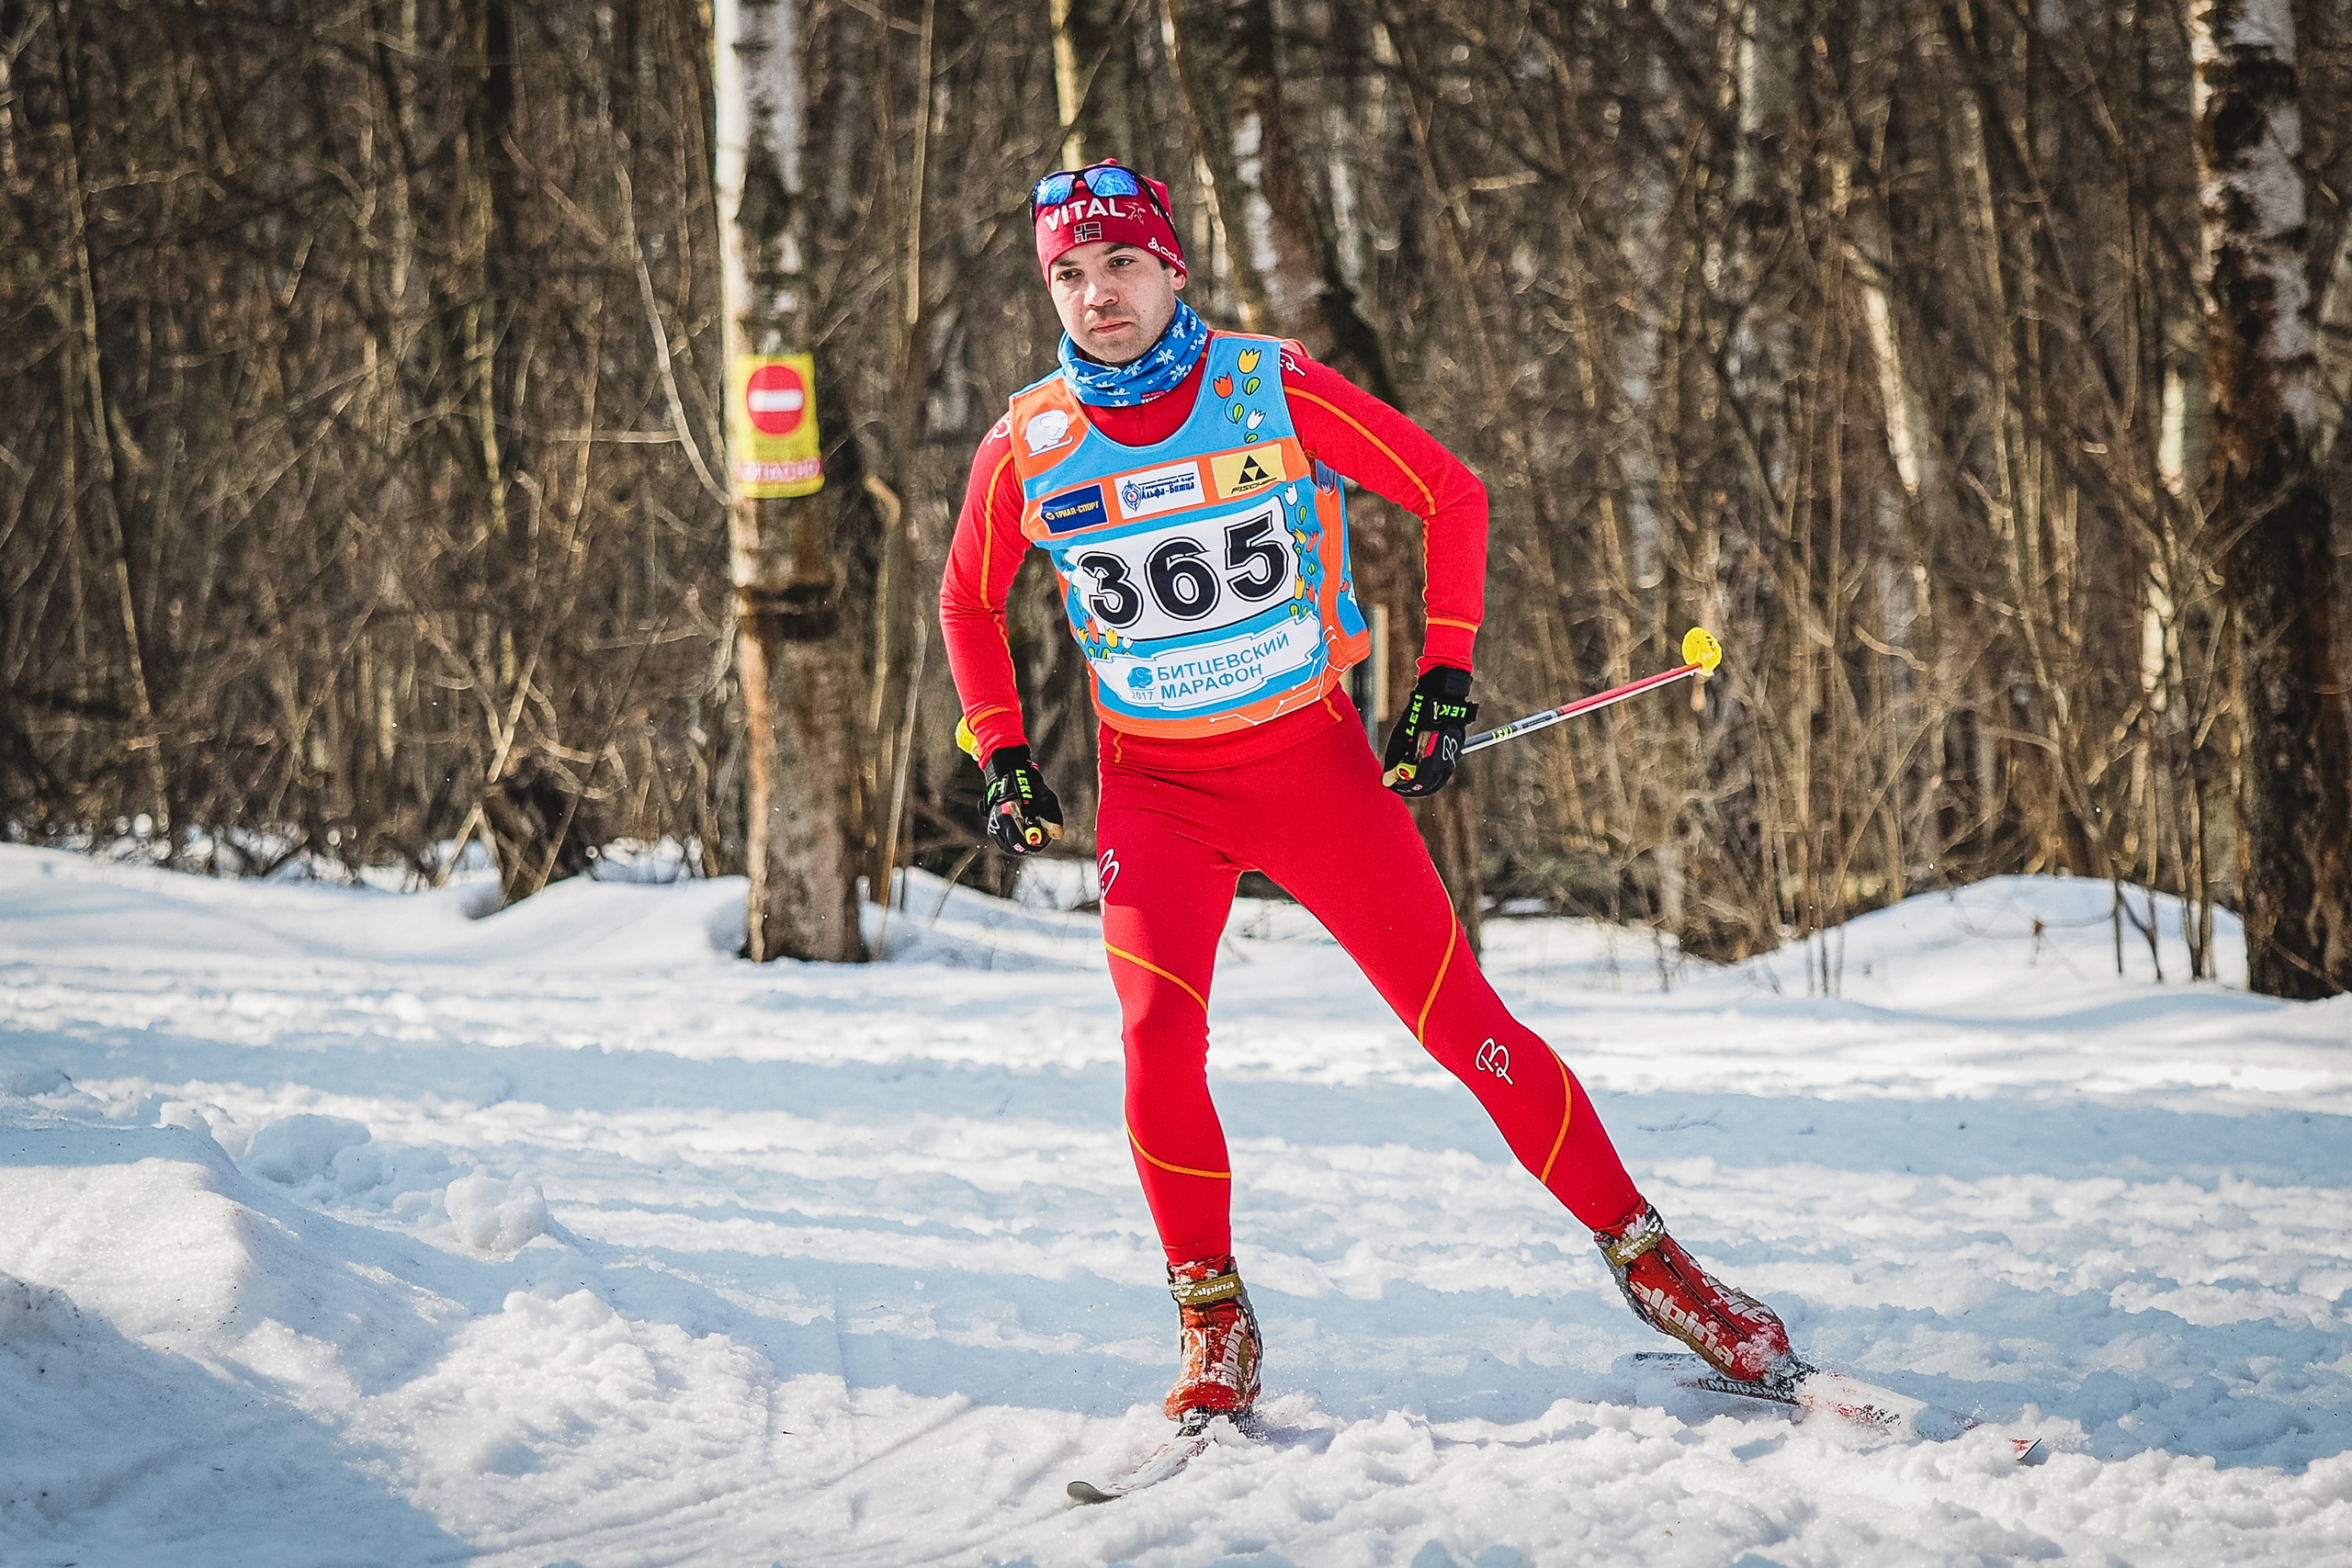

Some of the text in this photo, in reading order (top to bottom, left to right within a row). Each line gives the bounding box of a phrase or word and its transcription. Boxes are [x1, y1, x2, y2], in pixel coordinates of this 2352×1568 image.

[1046, 197, 1126, 231] VITAL
[1078, 511, 1288, 630] 365
[1157, 630, 1290, 682] БИТЦЕВСКИЙ
[1131, 691, 1154, 701] 2017
[1160, 663, 1263, 700] МАРАФОН
[1406, 694, 1424, 737] LEKI
[1015, 769, 1033, 799] LEKI
[1193, 1280, 1235, 1296] alpina
[1629, 1280, 1735, 1368] alpina
